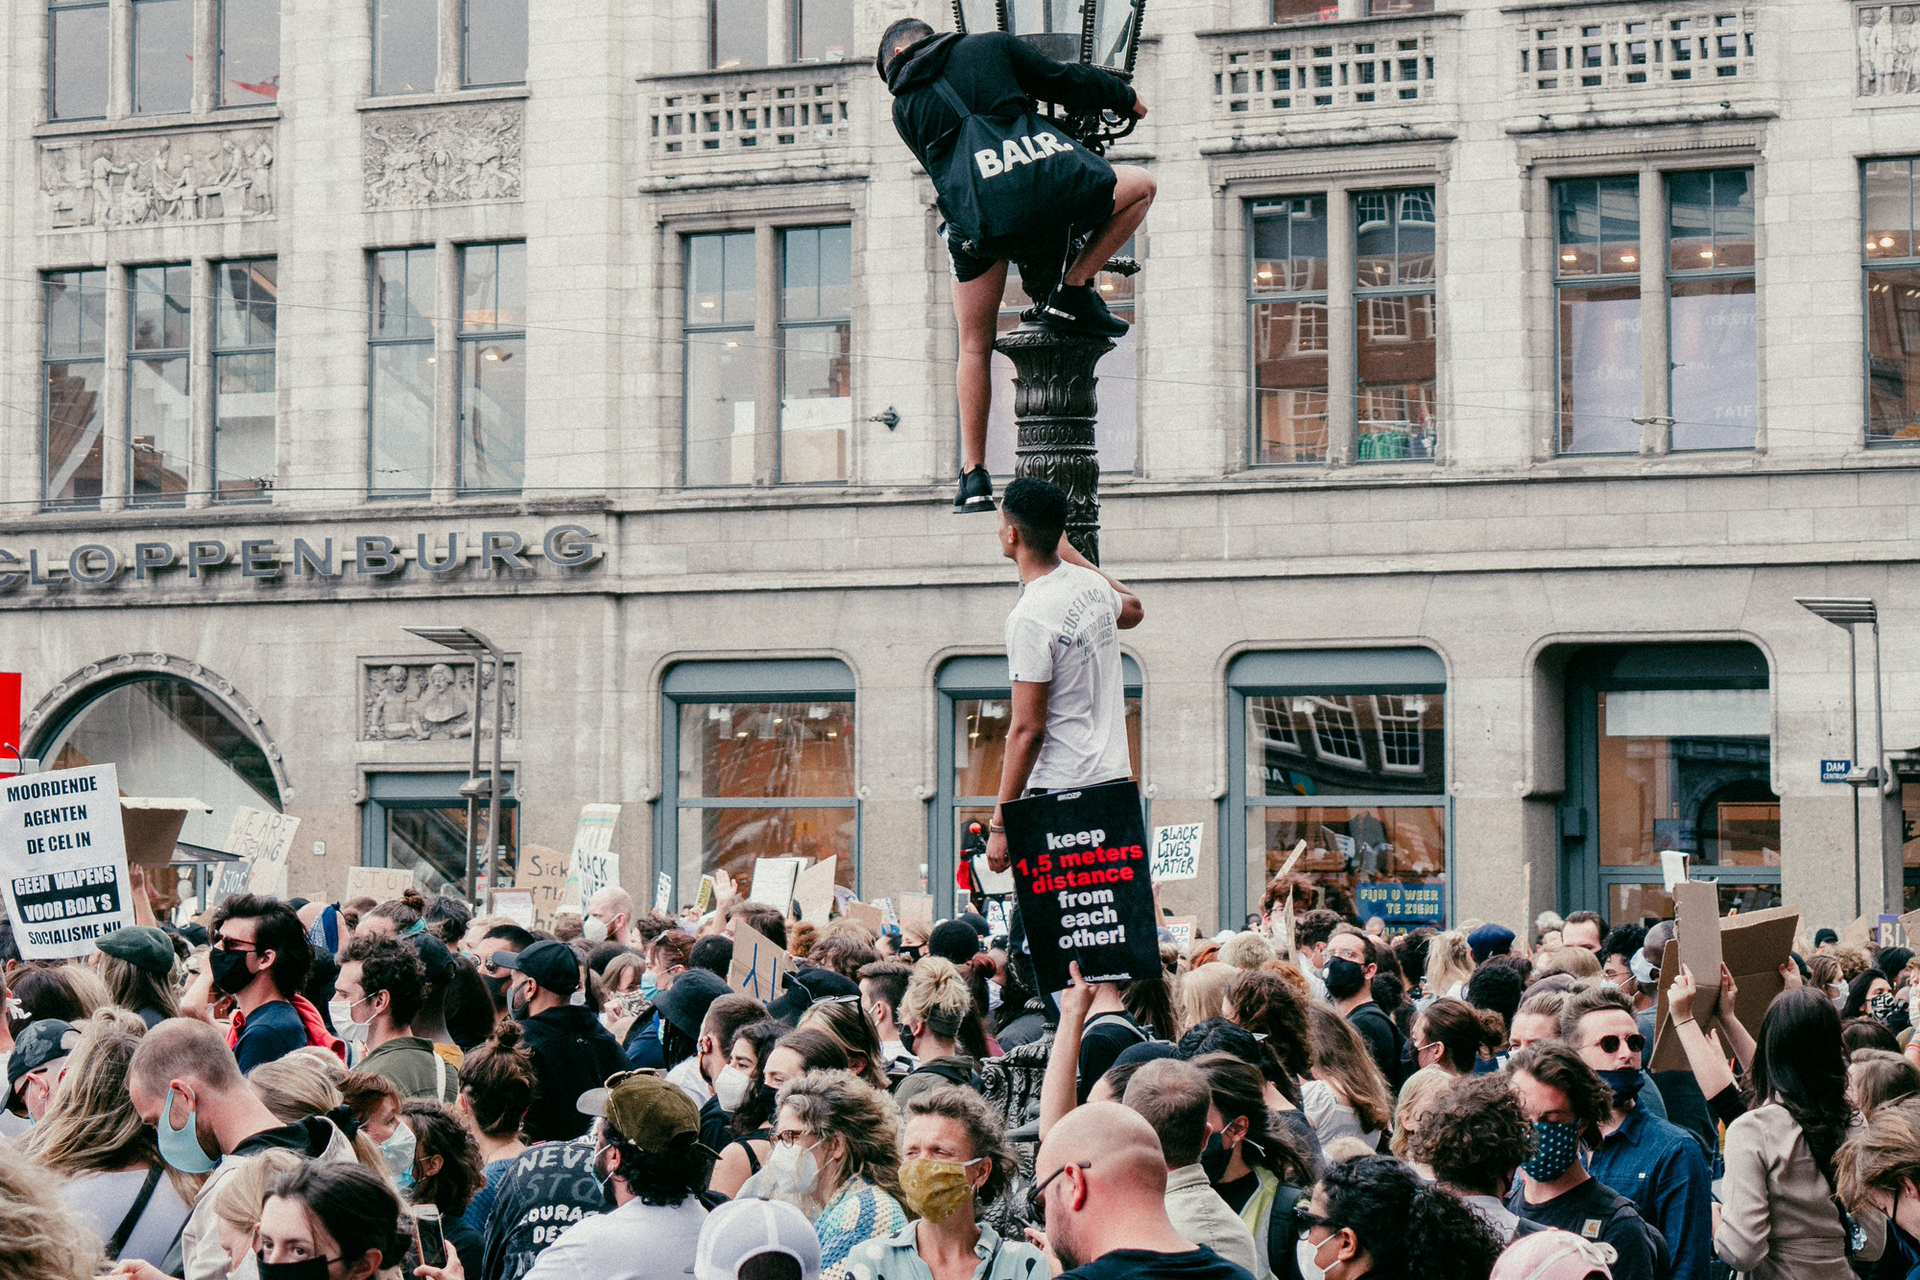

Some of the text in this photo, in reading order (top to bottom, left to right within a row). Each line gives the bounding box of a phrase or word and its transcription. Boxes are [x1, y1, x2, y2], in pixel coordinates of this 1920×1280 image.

[974, 132, 1074, 179] BALR.
[1825, 762, 1846, 772] DAM
[7, 776, 97, 802] MOORDENDE
[24, 804, 87, 827] AGENTEN
[27, 831, 91, 855] DE CEL IN
[1046, 829, 1106, 850] keep
[1160, 826, 1198, 843] BLACK
[1158, 841, 1191, 858] LIVES
[528, 855, 569, 877] Sick
[1016, 845, 1143, 877] 1,5 meters
[1151, 857, 1194, 875] MATTER
[14, 865, 115, 896] GEEN WAPENS
[1032, 866, 1135, 893] distance
[1058, 889, 1114, 909] from
[1361, 889, 1438, 902] FIJN U WEER
[23, 893, 112, 922] VOOR BOA'S
[1061, 906, 1118, 928] each
[1386, 903, 1439, 914] TE ZIEN!
[1059, 925, 1126, 949] other!
[517, 1146, 597, 1177] NEVE
